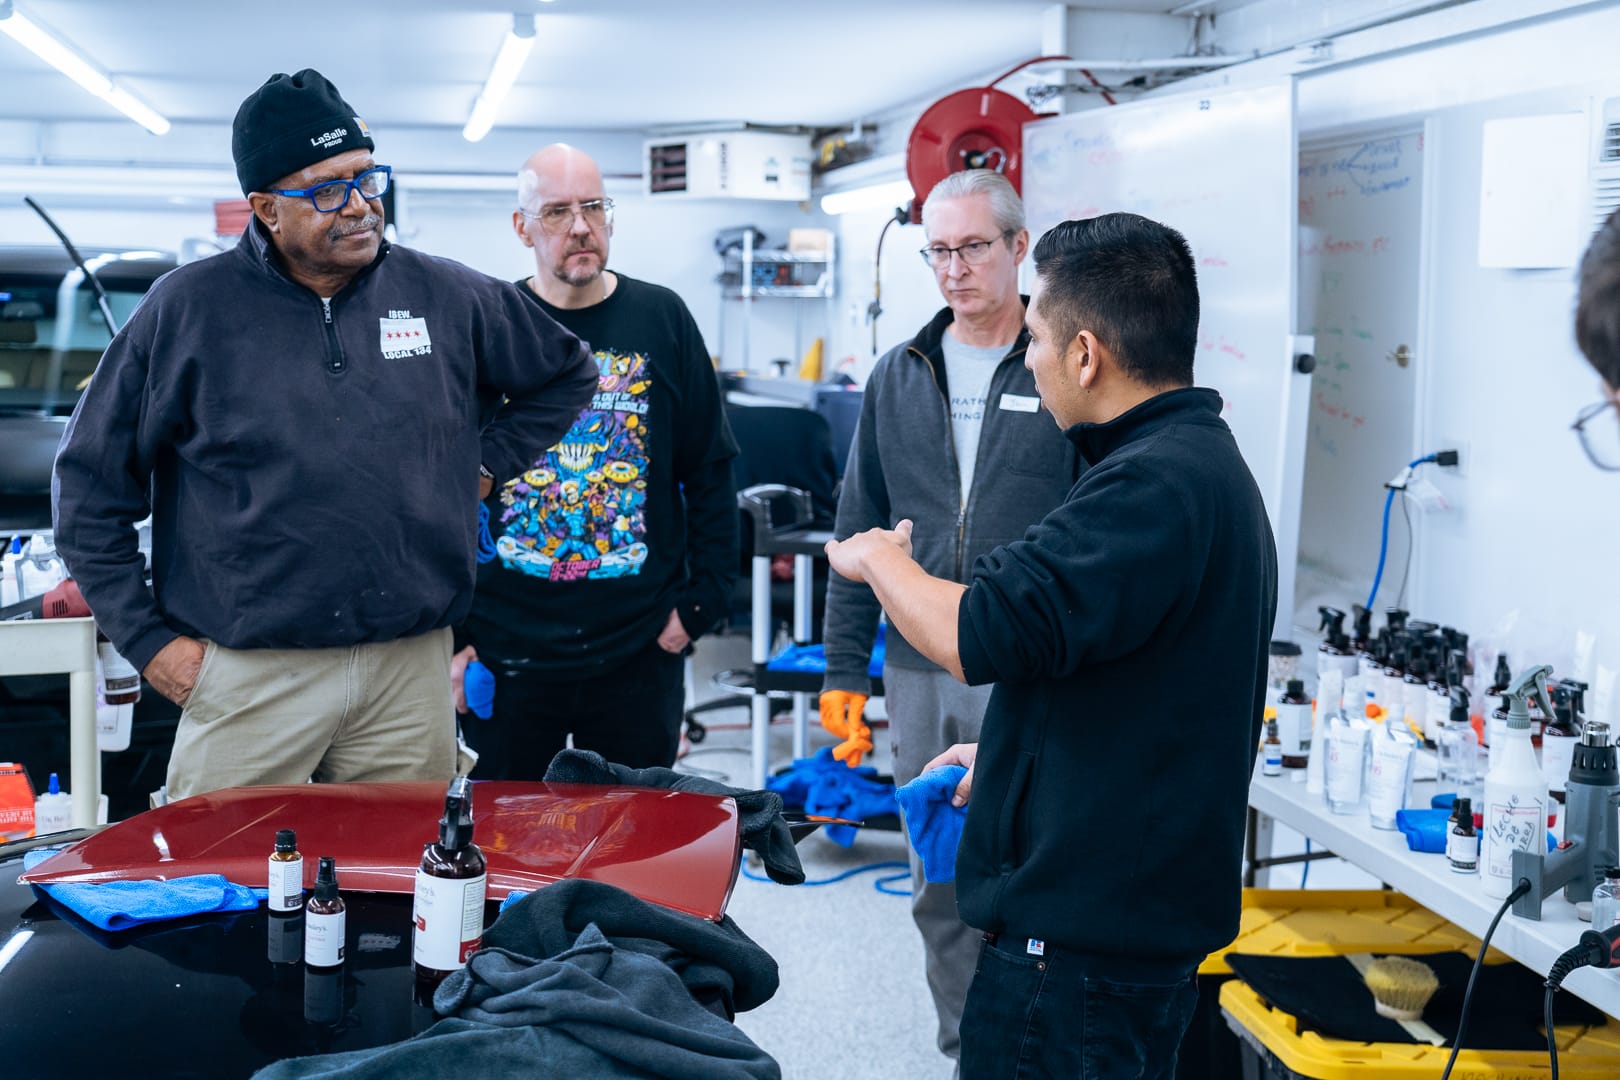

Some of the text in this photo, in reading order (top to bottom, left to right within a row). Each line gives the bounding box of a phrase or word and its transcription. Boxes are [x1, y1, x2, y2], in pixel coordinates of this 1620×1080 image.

[310, 128, 348, 147] LaSalle
[383, 345, 432, 360] LOCAL 134
